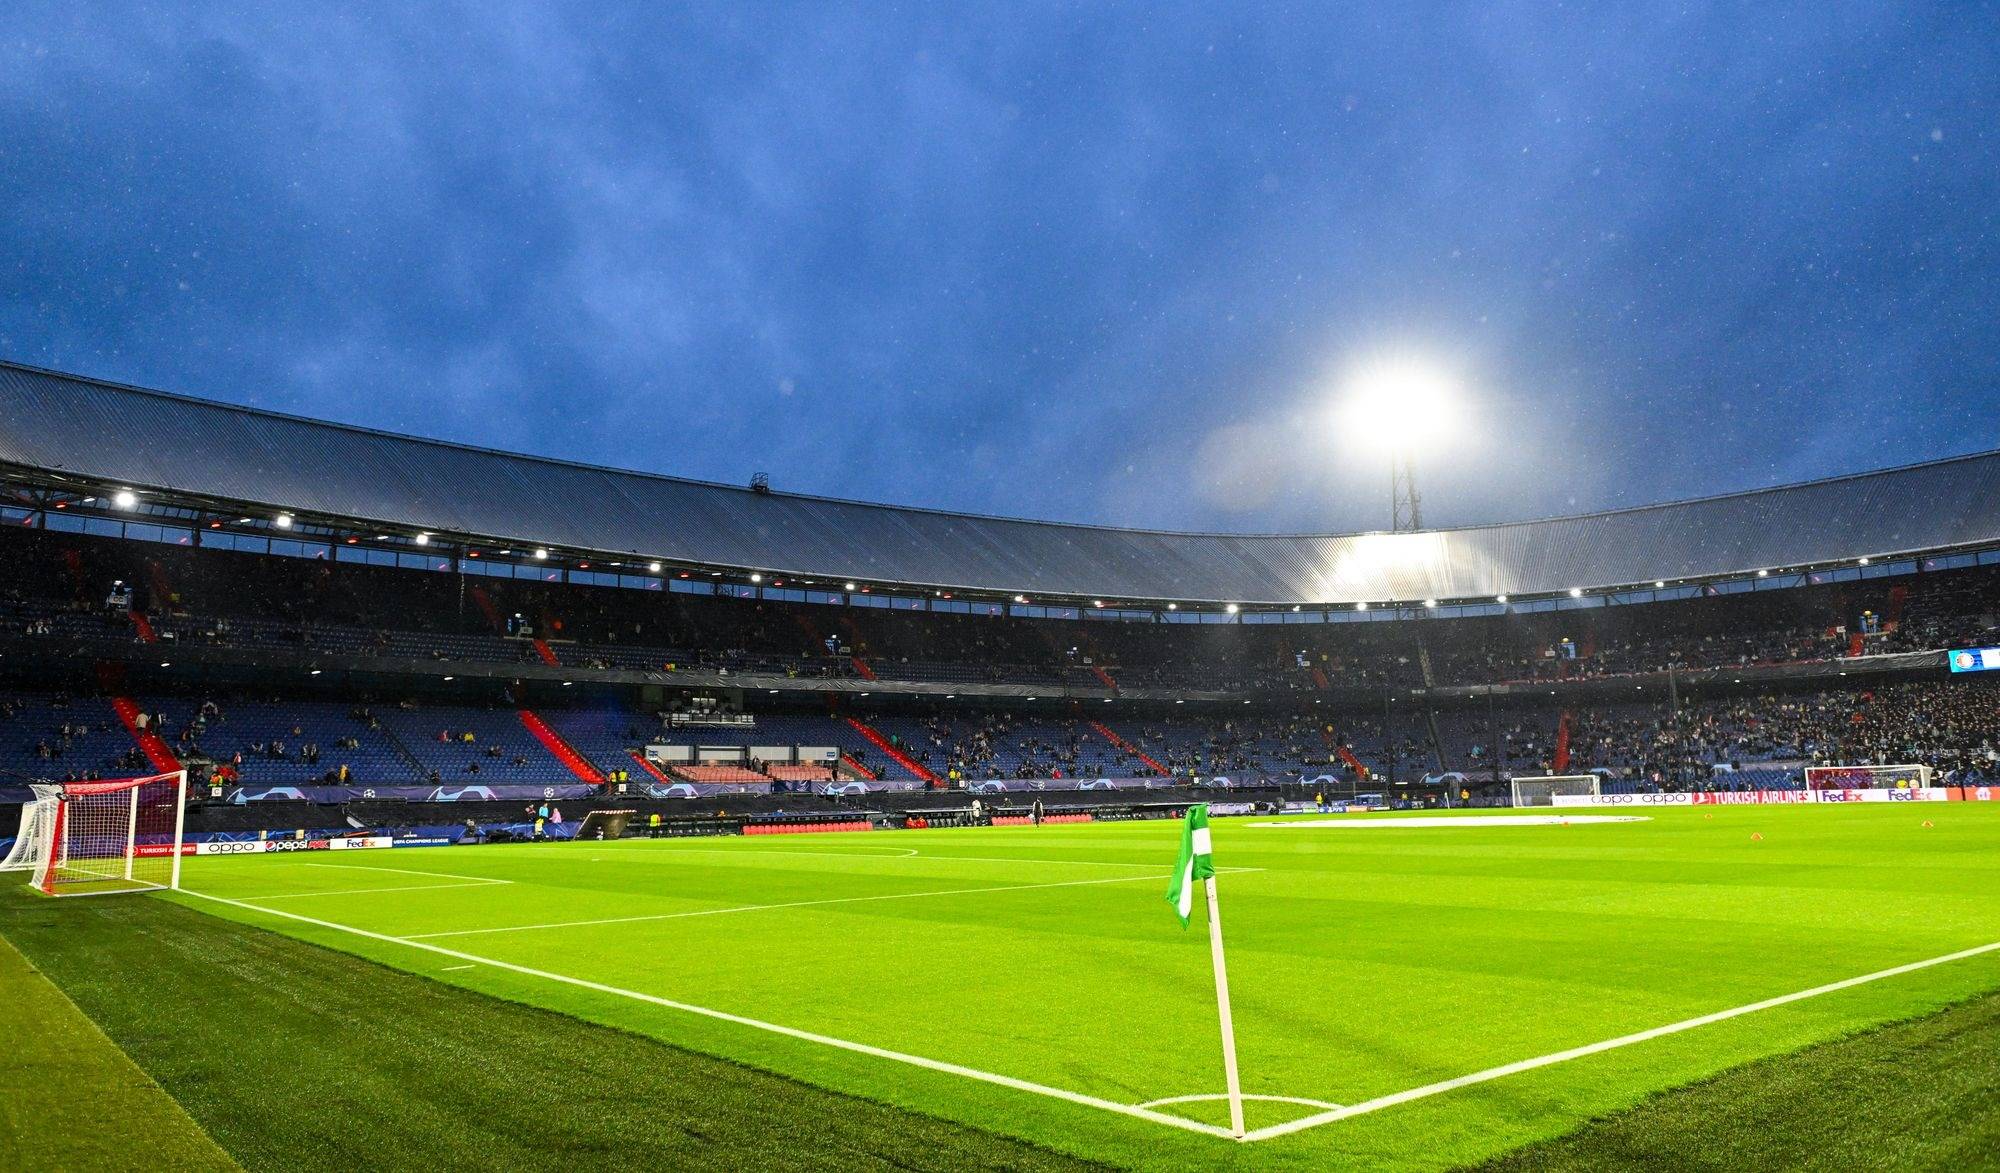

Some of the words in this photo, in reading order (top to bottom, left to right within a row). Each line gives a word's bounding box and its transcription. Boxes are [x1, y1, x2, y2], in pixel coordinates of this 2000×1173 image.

[1642, 794, 1686, 805] oppo
[1714, 791, 1758, 804] TURKISH
[1762, 790, 1808, 803] AIRLINES
[1822, 788, 1863, 802] FedEx
[1888, 788, 1931, 801] FedEx
[209, 843, 254, 855] oppo
[276, 839, 308, 852] pepsi
[346, 839, 375, 848] FedEx
